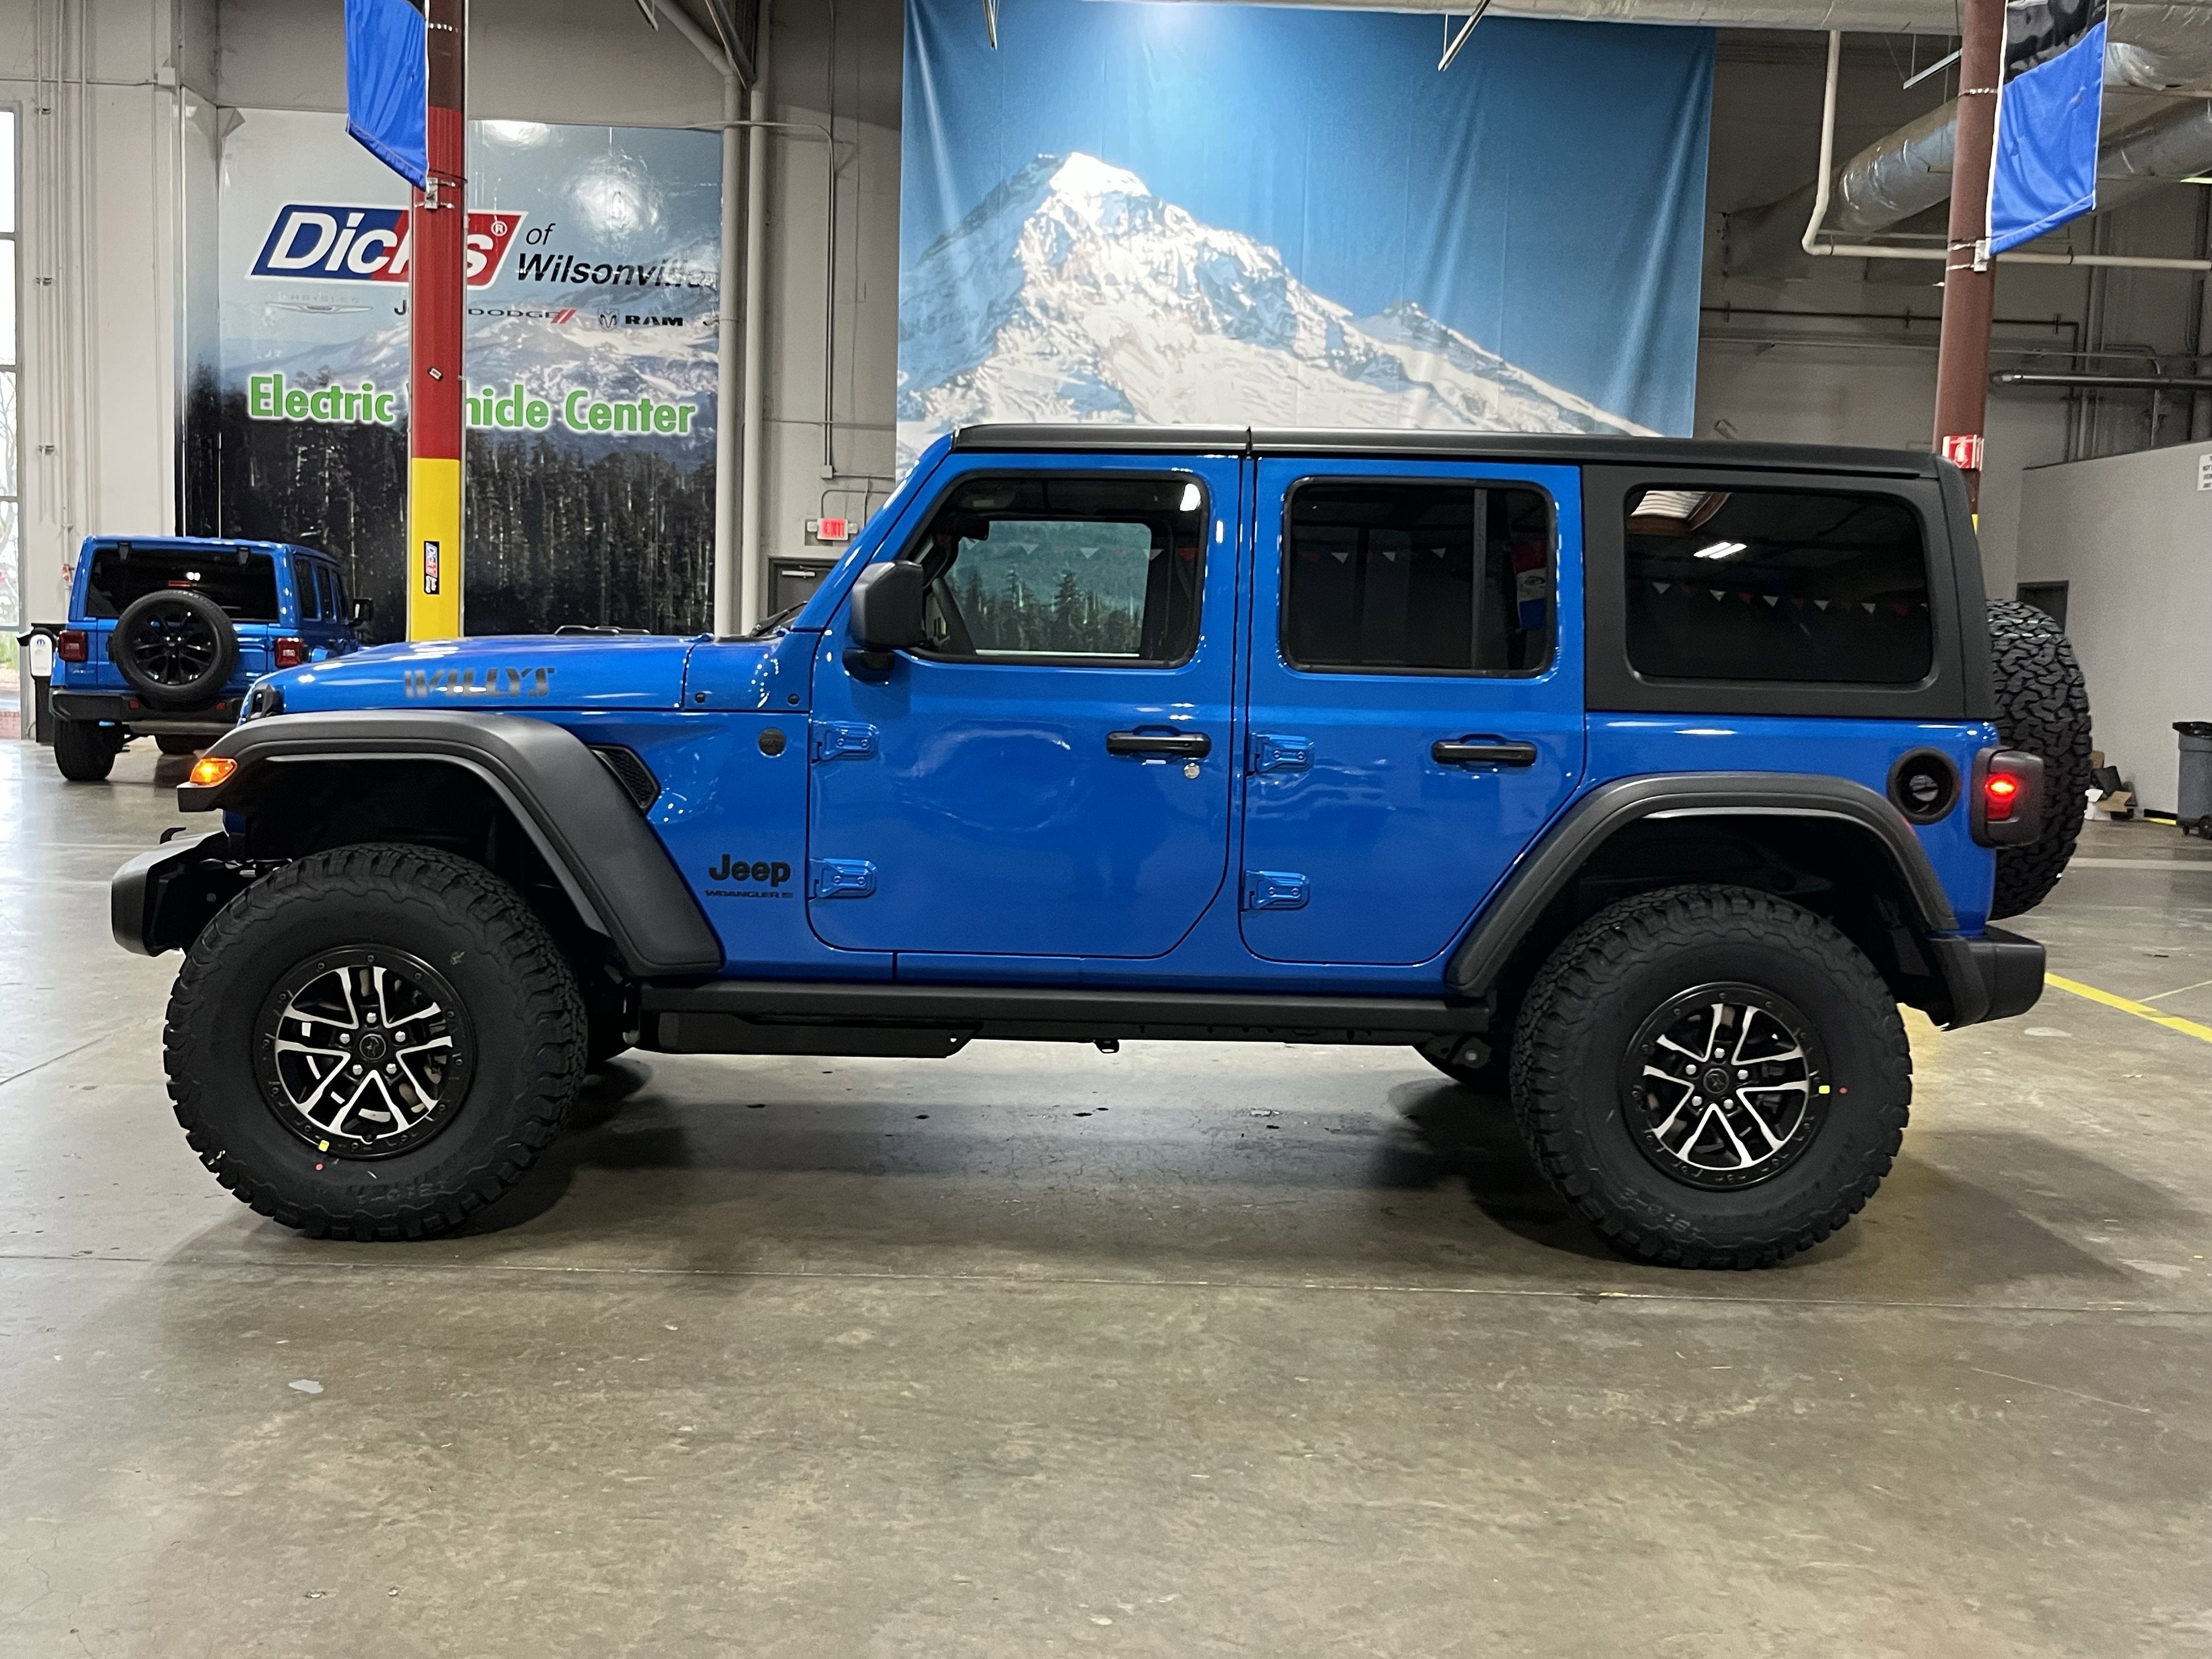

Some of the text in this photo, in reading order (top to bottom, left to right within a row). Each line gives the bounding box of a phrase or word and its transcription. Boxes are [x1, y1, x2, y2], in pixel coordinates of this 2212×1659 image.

[526, 223, 556, 245] of
[267, 212, 494, 278] Dics
[279, 294, 360, 303] HRYSLER
[469, 308, 560, 318] DODGE
[625, 315, 683, 326] RAM
[251, 374, 393, 422] Electric
[566, 390, 696, 433] Center
[823, 520, 845, 537] EXIT
[708, 854, 791, 887] Jeep
